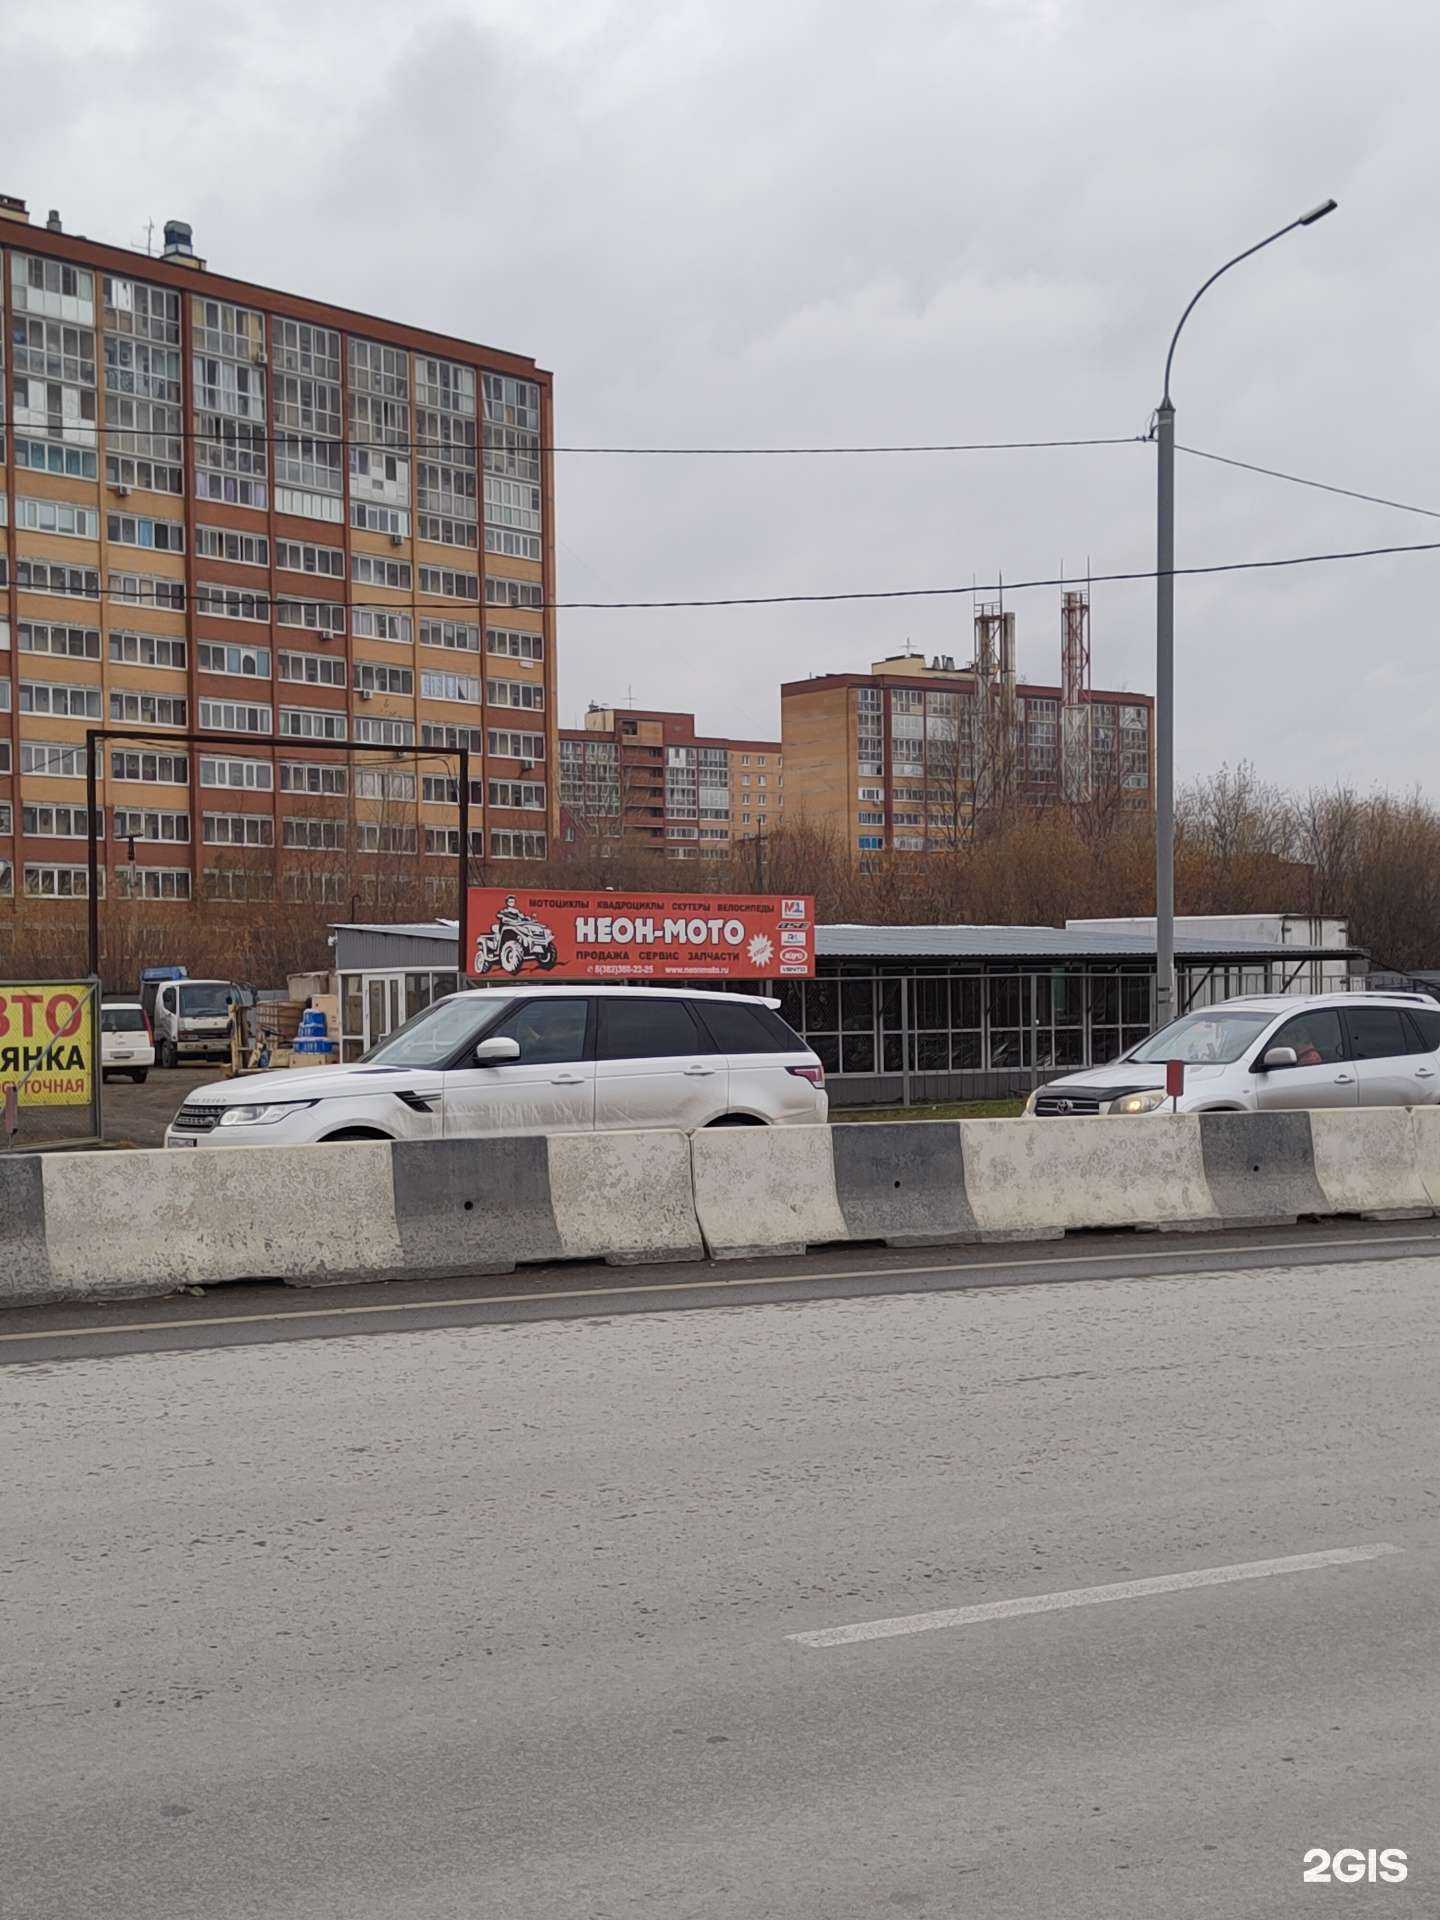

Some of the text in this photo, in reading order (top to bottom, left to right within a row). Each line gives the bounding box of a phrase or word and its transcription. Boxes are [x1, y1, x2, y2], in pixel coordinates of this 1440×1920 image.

[529, 898, 775, 912] МОТОЦИКЛЫ КВАДРОЦИКЛЫ СКУТЕРЫ ВЕЛОСИПЕДЫ
[575, 917, 745, 945] НЕОН-МОТО
[576, 950, 740, 962] ПРОДАЖА СЕРВИС ЗАПЧАСТИ
